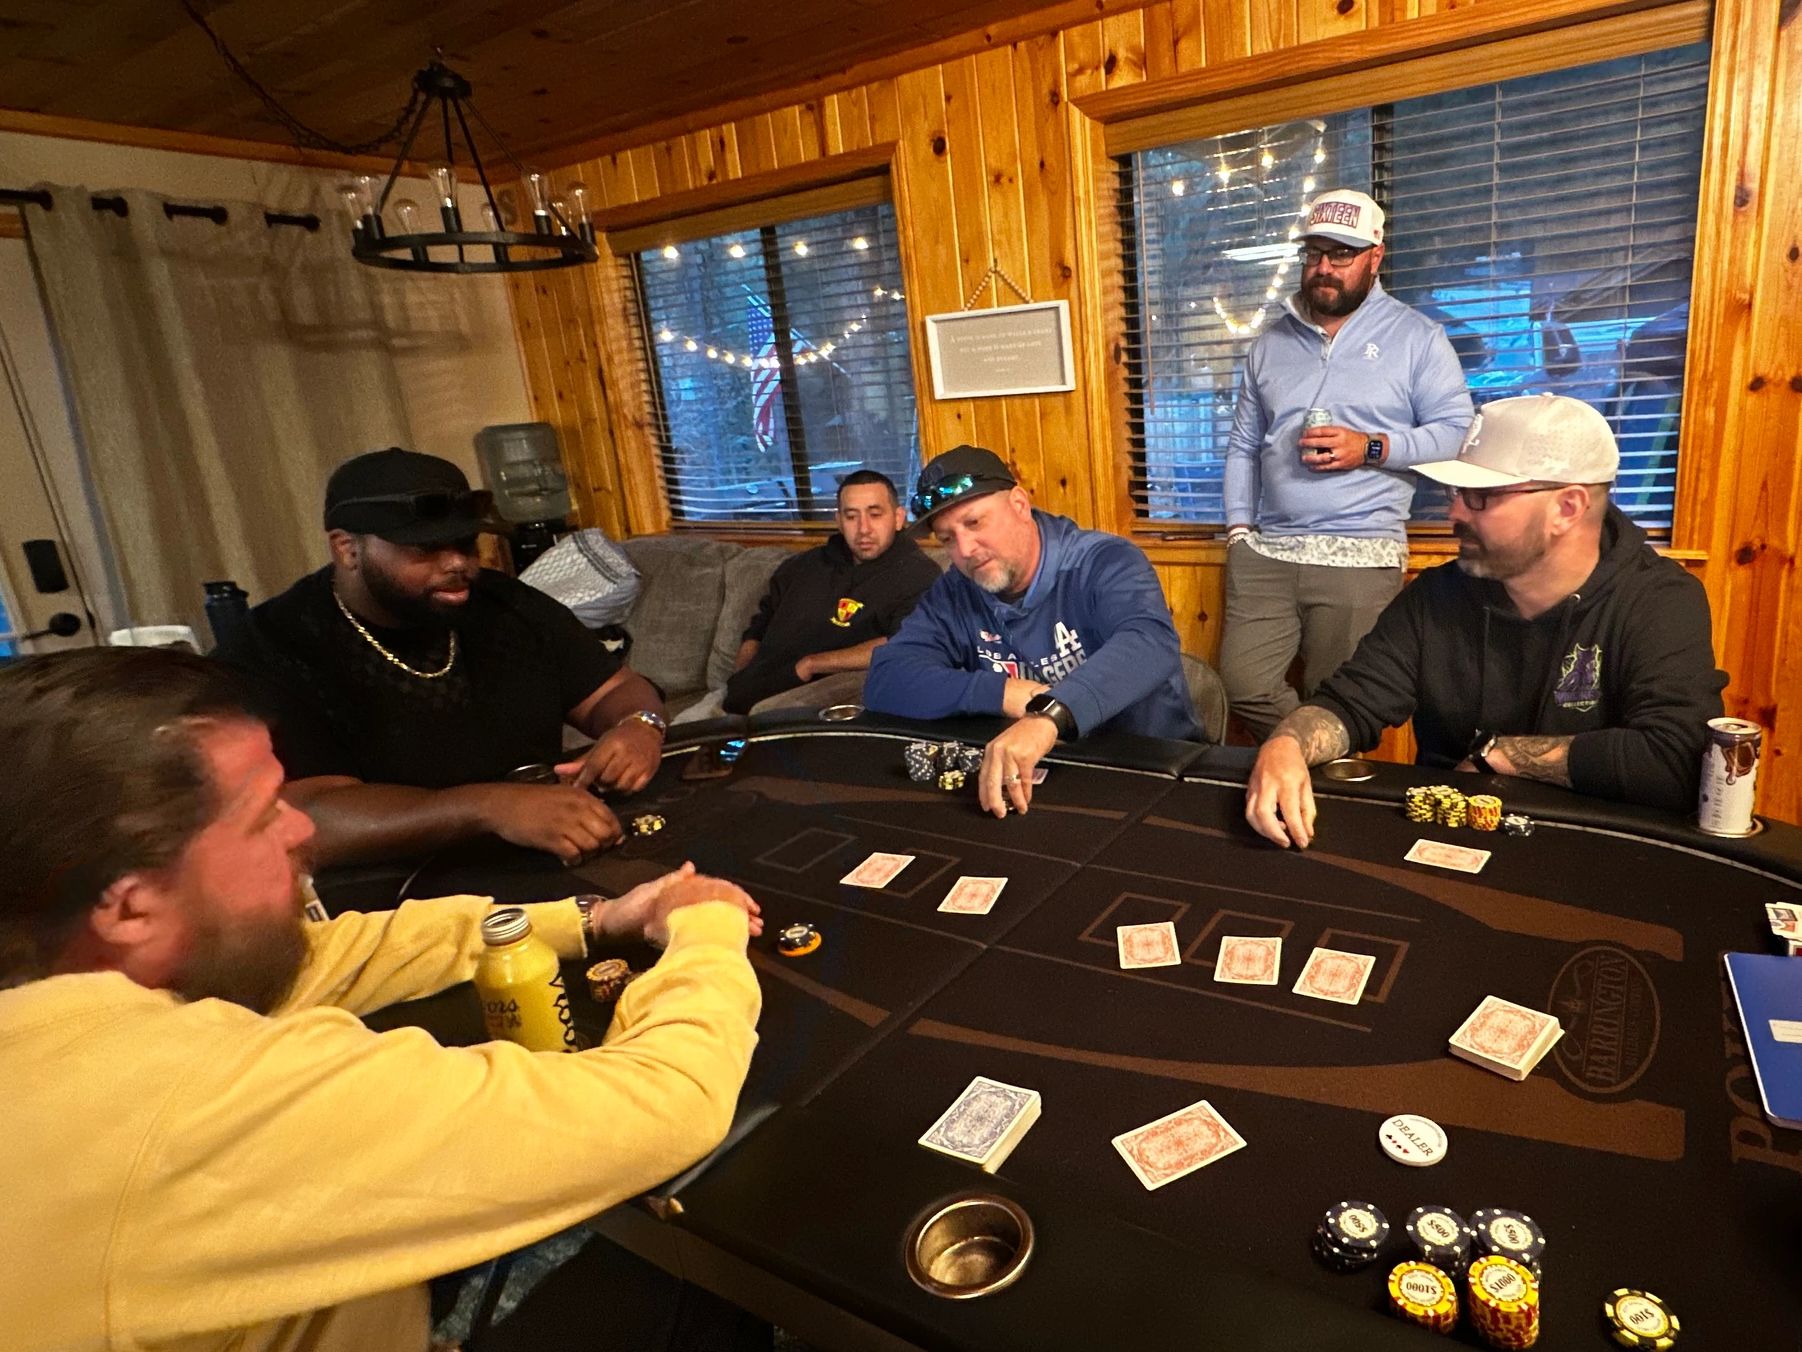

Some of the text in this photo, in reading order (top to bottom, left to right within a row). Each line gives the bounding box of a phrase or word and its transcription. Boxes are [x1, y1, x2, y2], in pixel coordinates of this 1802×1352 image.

[1310, 203, 1361, 228] SIXTEEN
[1584, 954, 1628, 1083] BARRINGTON
[1392, 1119, 1433, 1156] DEALER
[1349, 1214, 1367, 1233] $500
[1427, 1219, 1450, 1238] $500
[1503, 1223, 1520, 1244] $500
[1406, 1282, 1438, 1296] $1000
[1490, 1273, 1516, 1293] $1000
[1629, 1308, 1654, 1325] $100
